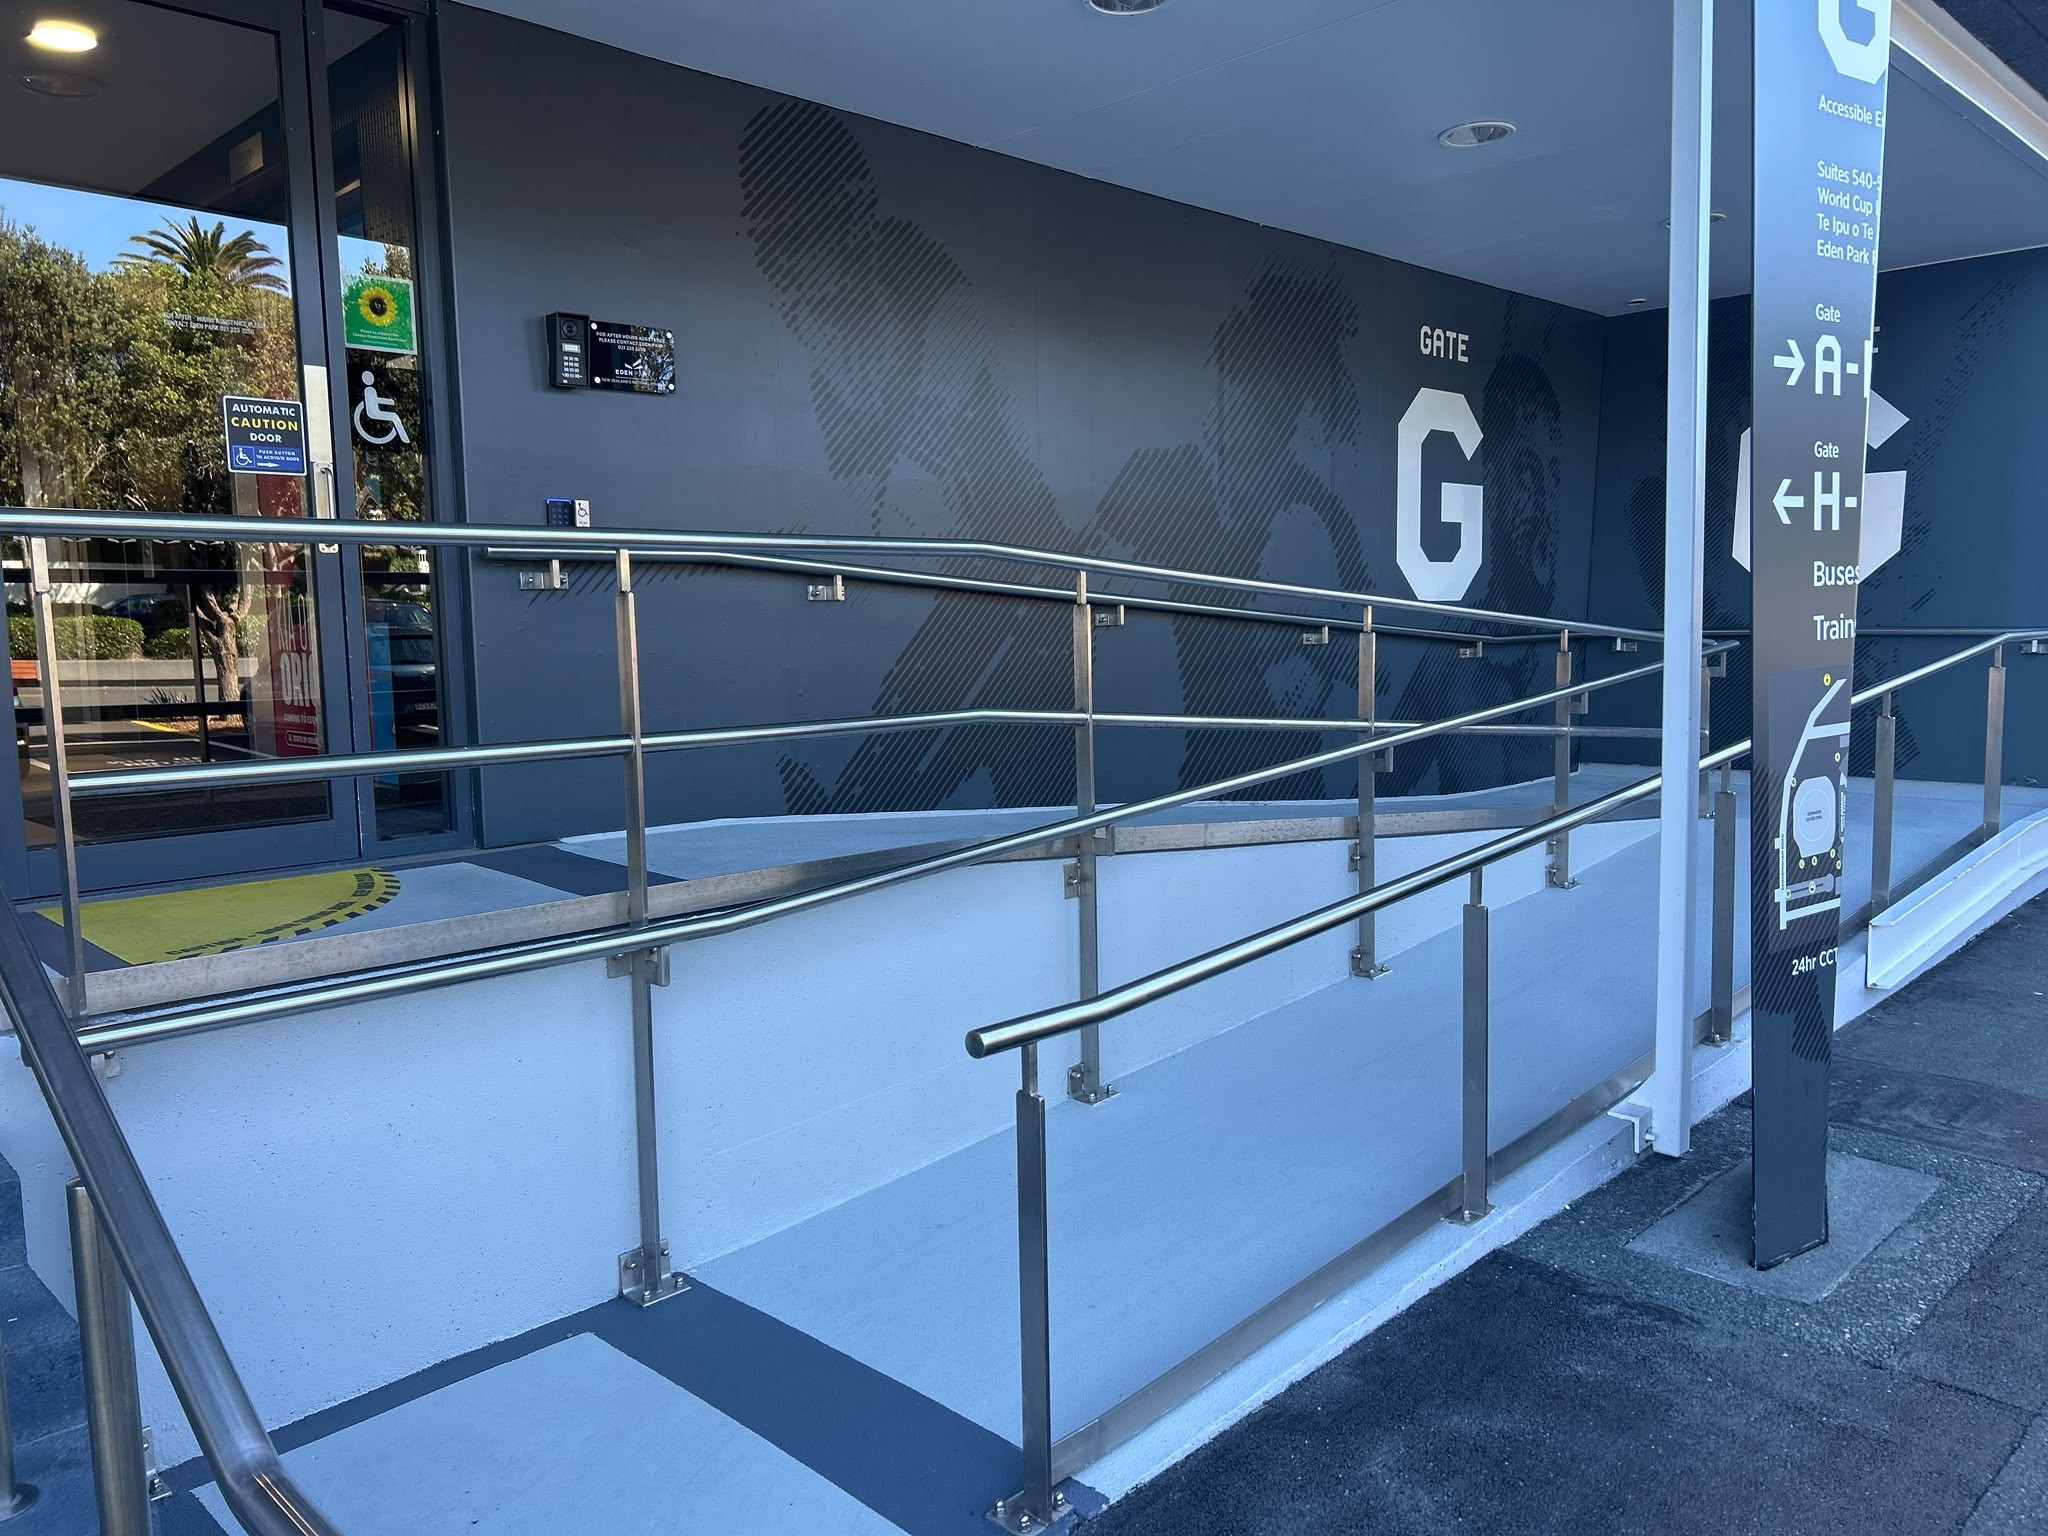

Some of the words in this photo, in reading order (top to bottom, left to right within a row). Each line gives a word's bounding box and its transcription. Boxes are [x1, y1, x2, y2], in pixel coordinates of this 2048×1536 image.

[1818, 94, 1873, 125] Accessible
[1817, 160, 1850, 183] Suites
[1817, 186, 1850, 209] World
[1852, 195, 1873, 216] Cup
[1817, 213, 1830, 231] Te
[1832, 216, 1850, 236] Ipu
[1852, 226, 1860, 237] o
[1862, 223, 1874, 240] Te
[1817, 239, 1844, 260] Eden
[1846, 248, 1870, 266] Park
[1815, 303, 1841, 322] Gate
[1419, 325, 1469, 363] GATE
[615, 368, 633, 376] EDEN
[232, 403, 296, 417] AUTOMATIC
[231, 416, 298, 431] CAUTION
[250, 432, 282, 443] DOOR
[1814, 441, 1840, 459] Gate
[1396, 387, 1484, 601] G
[1791, 955, 1817, 976] 24hr
